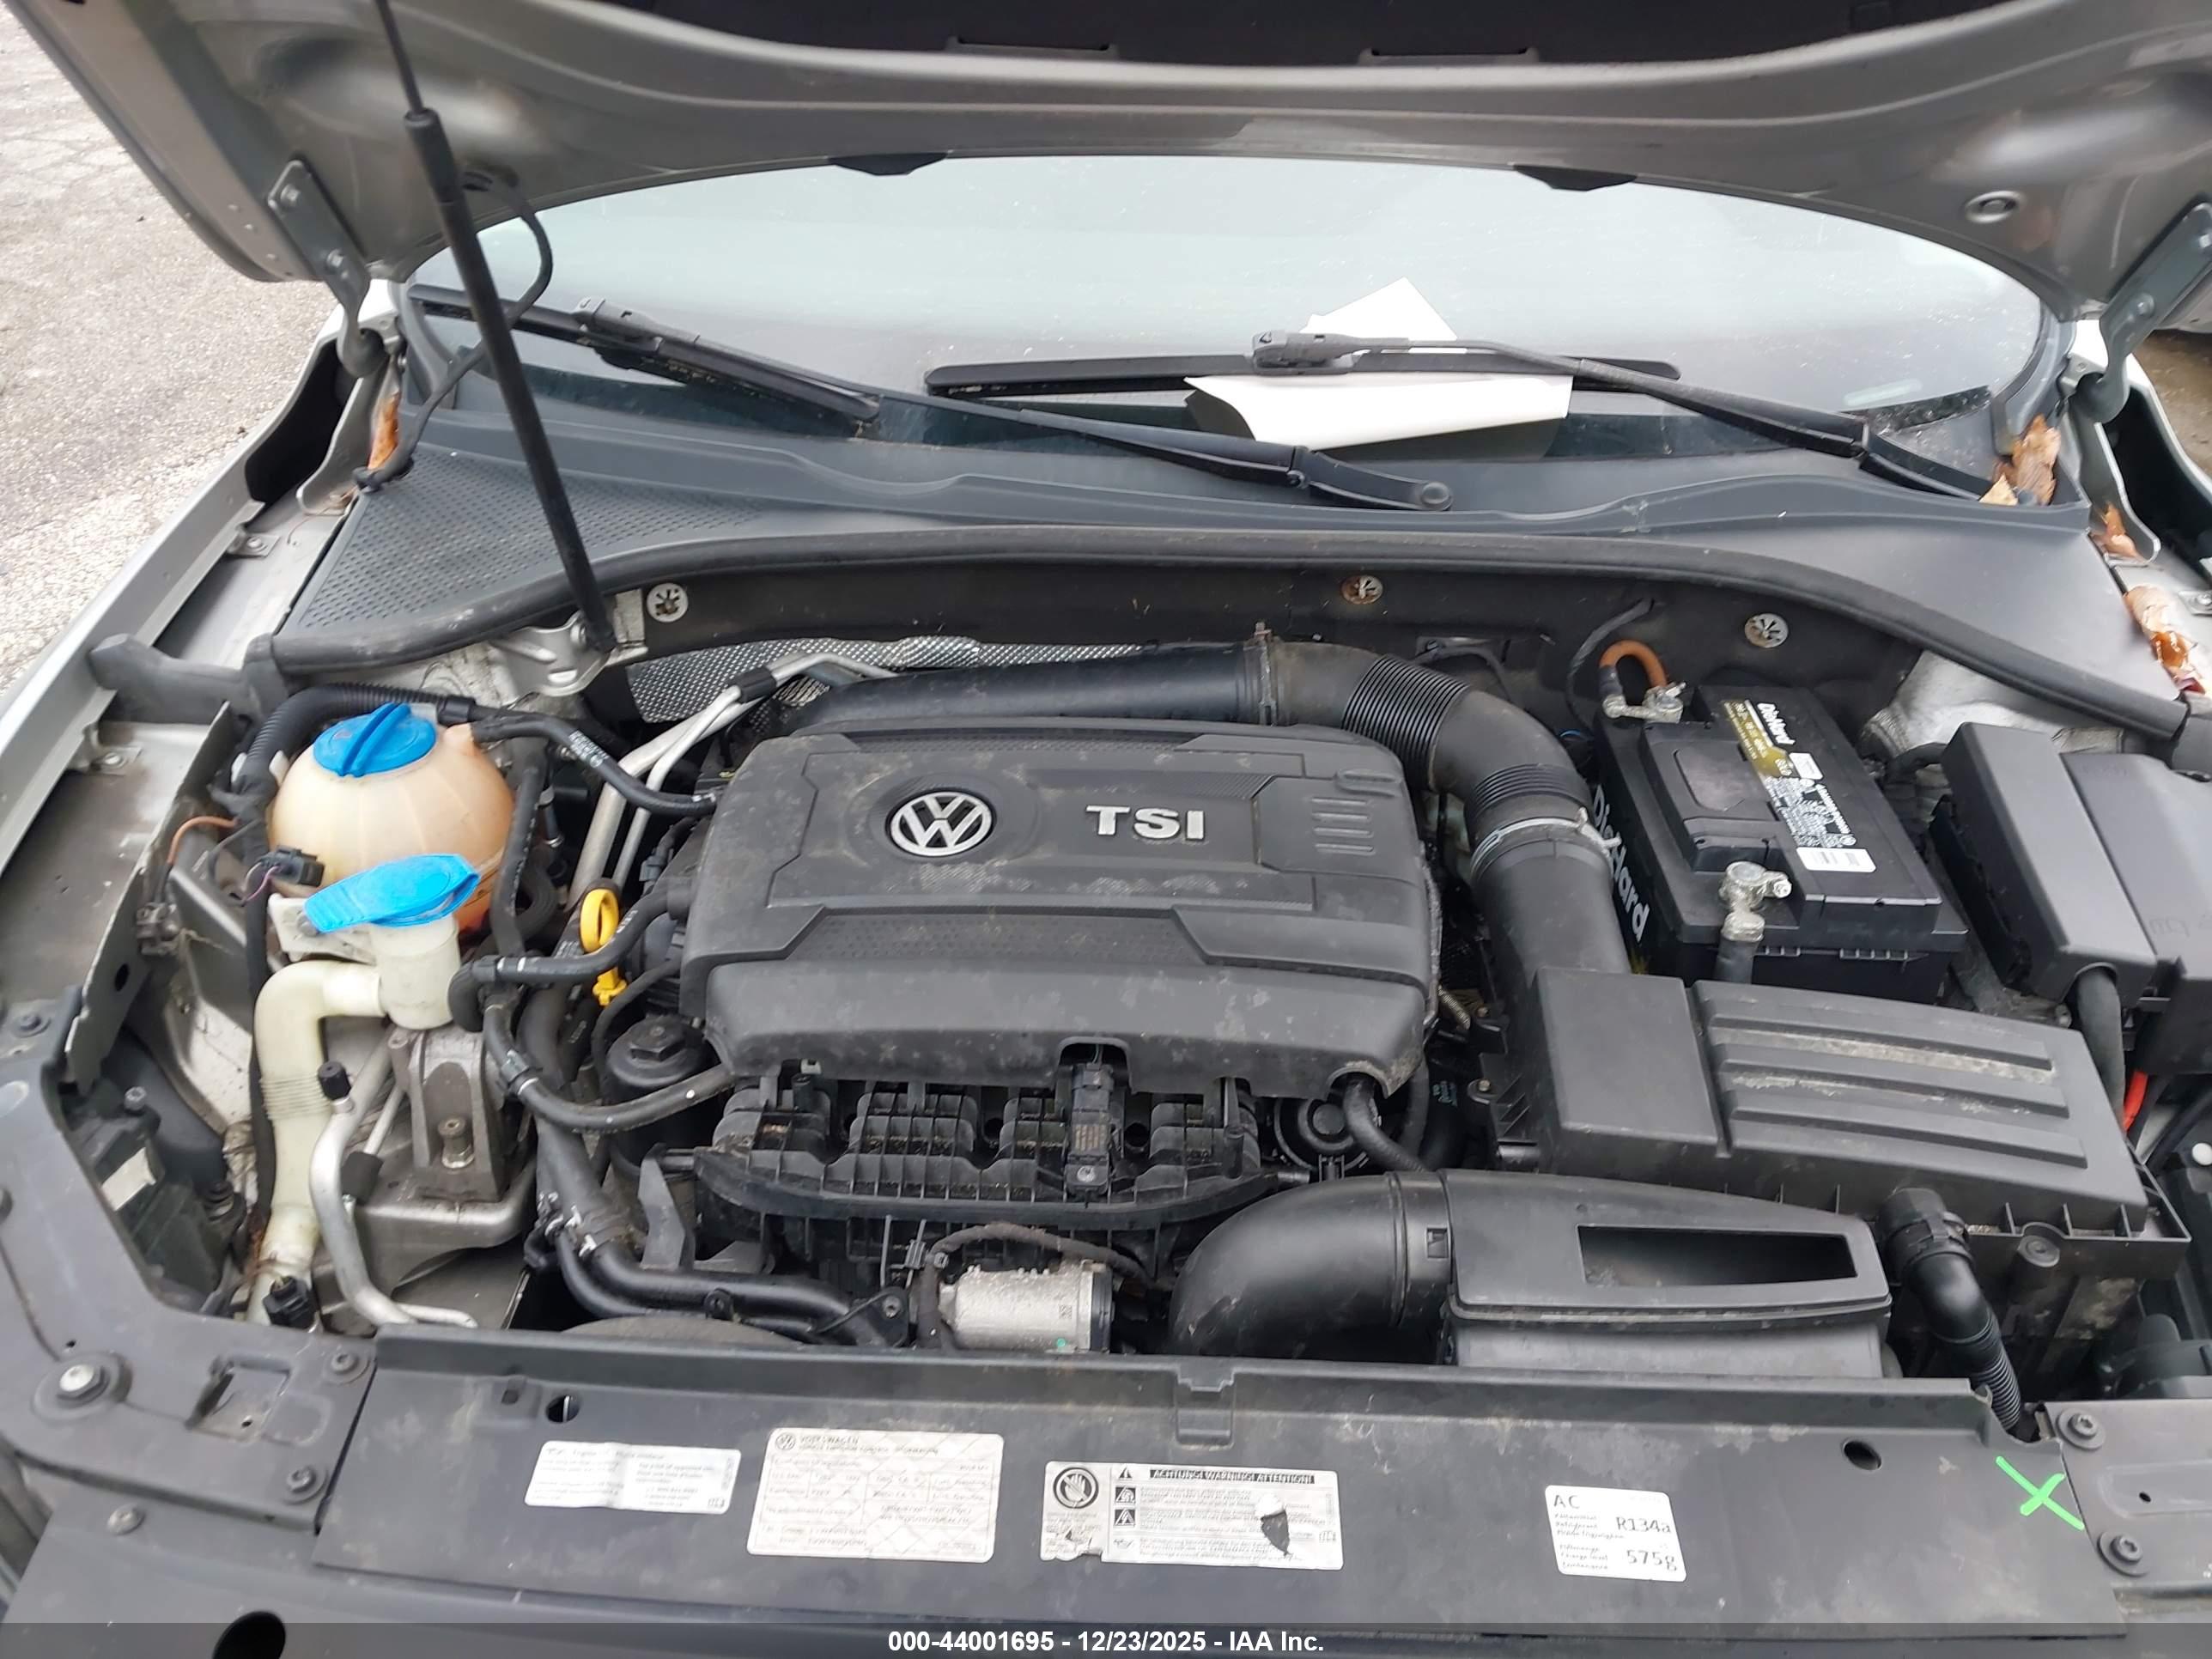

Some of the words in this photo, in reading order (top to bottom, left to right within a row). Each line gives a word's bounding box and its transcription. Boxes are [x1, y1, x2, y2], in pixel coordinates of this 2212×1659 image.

[1757, 702, 1796, 745] DieHard
[1085, 804, 1206, 841] TSI
[1553, 1494, 1580, 1510] AC
[1615, 1516, 1672, 1534] R134a
[1626, 1549, 1677, 1571] 575g
